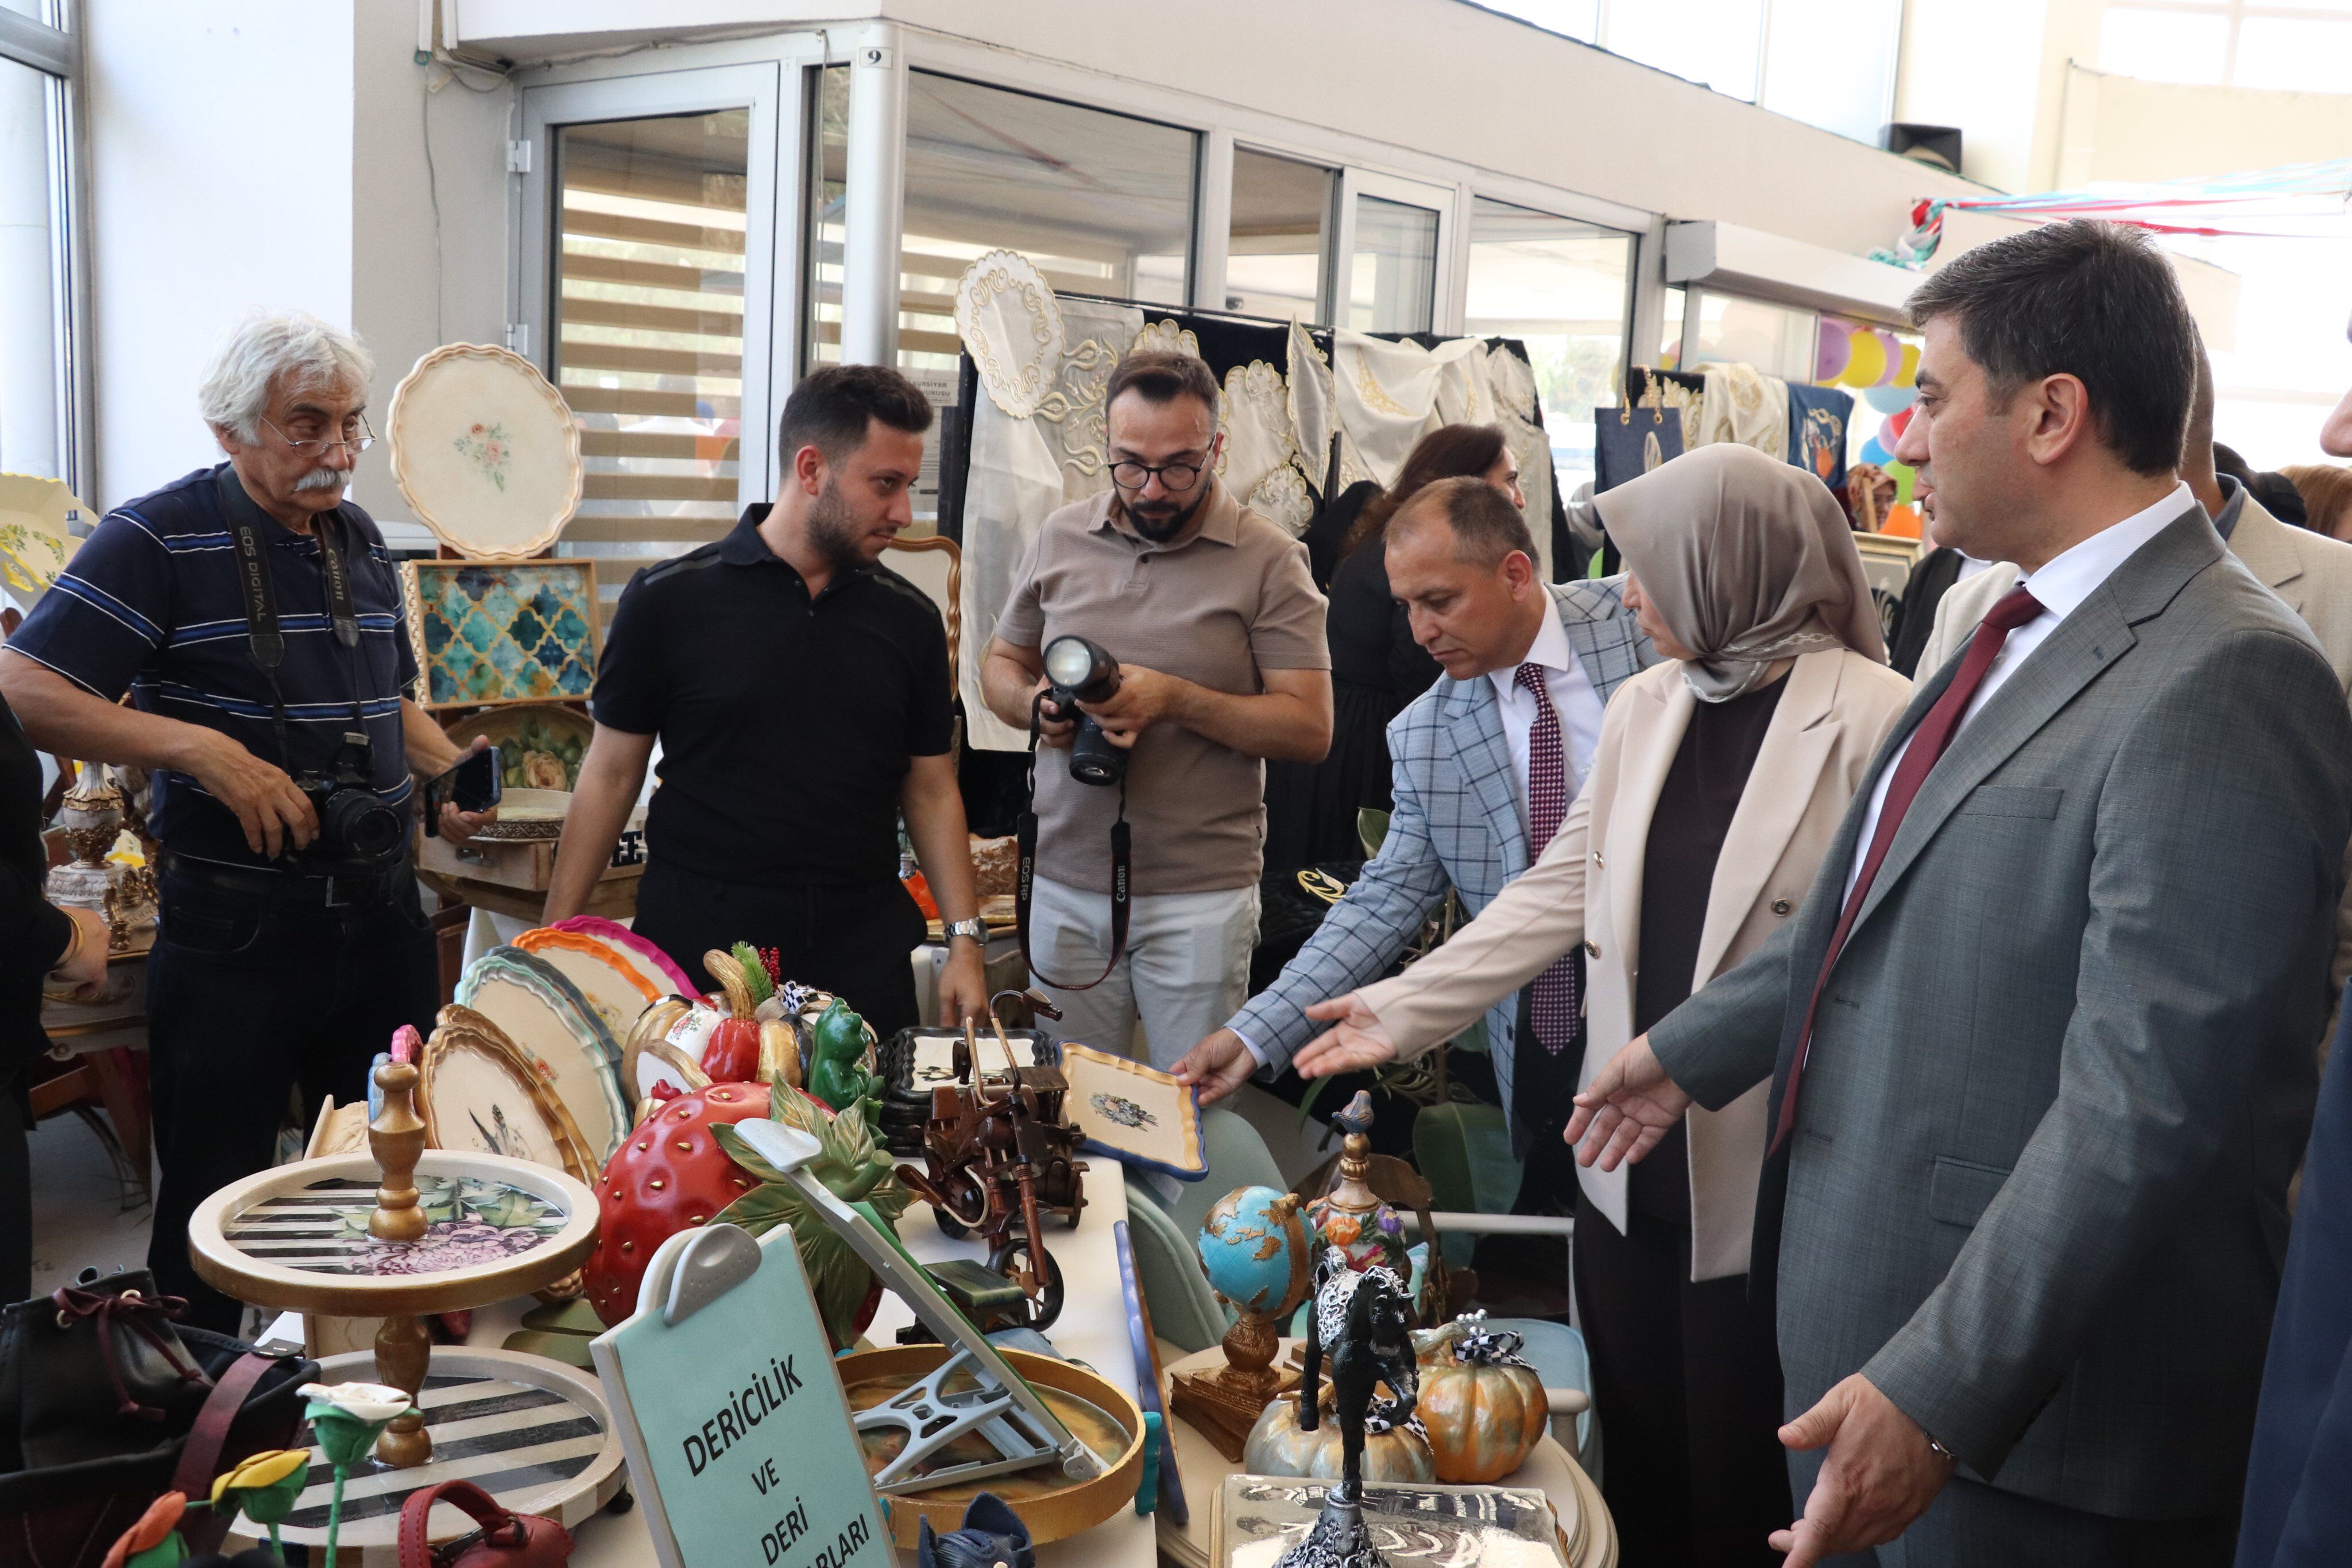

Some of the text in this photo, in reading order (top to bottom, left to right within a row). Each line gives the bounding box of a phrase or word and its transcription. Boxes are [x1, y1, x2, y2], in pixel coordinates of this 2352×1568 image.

[868, 49, 881, 64] 9
[239, 526, 266, 622] EOS DIGITAL
[328, 548, 344, 601] Canon
[1020, 857, 1030, 901] EOS RP
[1116, 865, 1125, 903] Canon
[683, 1354, 802, 1477] DERİCİLİK
[751, 1458, 780, 1495] VE
[761, 1496, 808, 1566] DERİ
